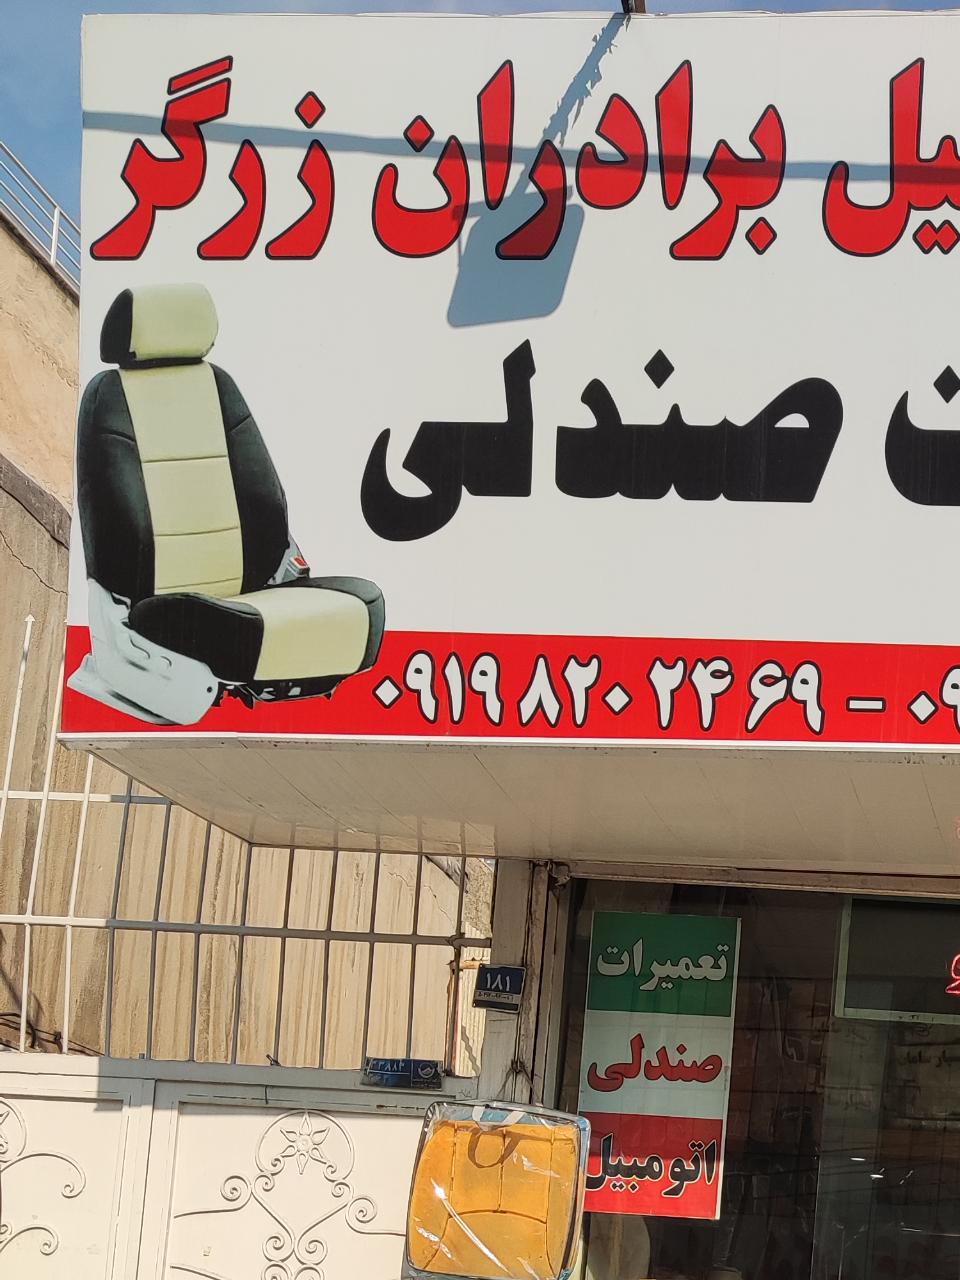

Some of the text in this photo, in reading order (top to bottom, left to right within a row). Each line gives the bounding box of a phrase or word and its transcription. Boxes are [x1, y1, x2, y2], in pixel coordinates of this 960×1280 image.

[89, 55, 335, 261] زرگر
[371, 58, 787, 261] برادران
[360, 338, 844, 543] صندلی
[486, 972, 511, 992] ۱۸۱
[595, 938, 730, 993] تعمیرات
[586, 1033, 723, 1094] صندلی
